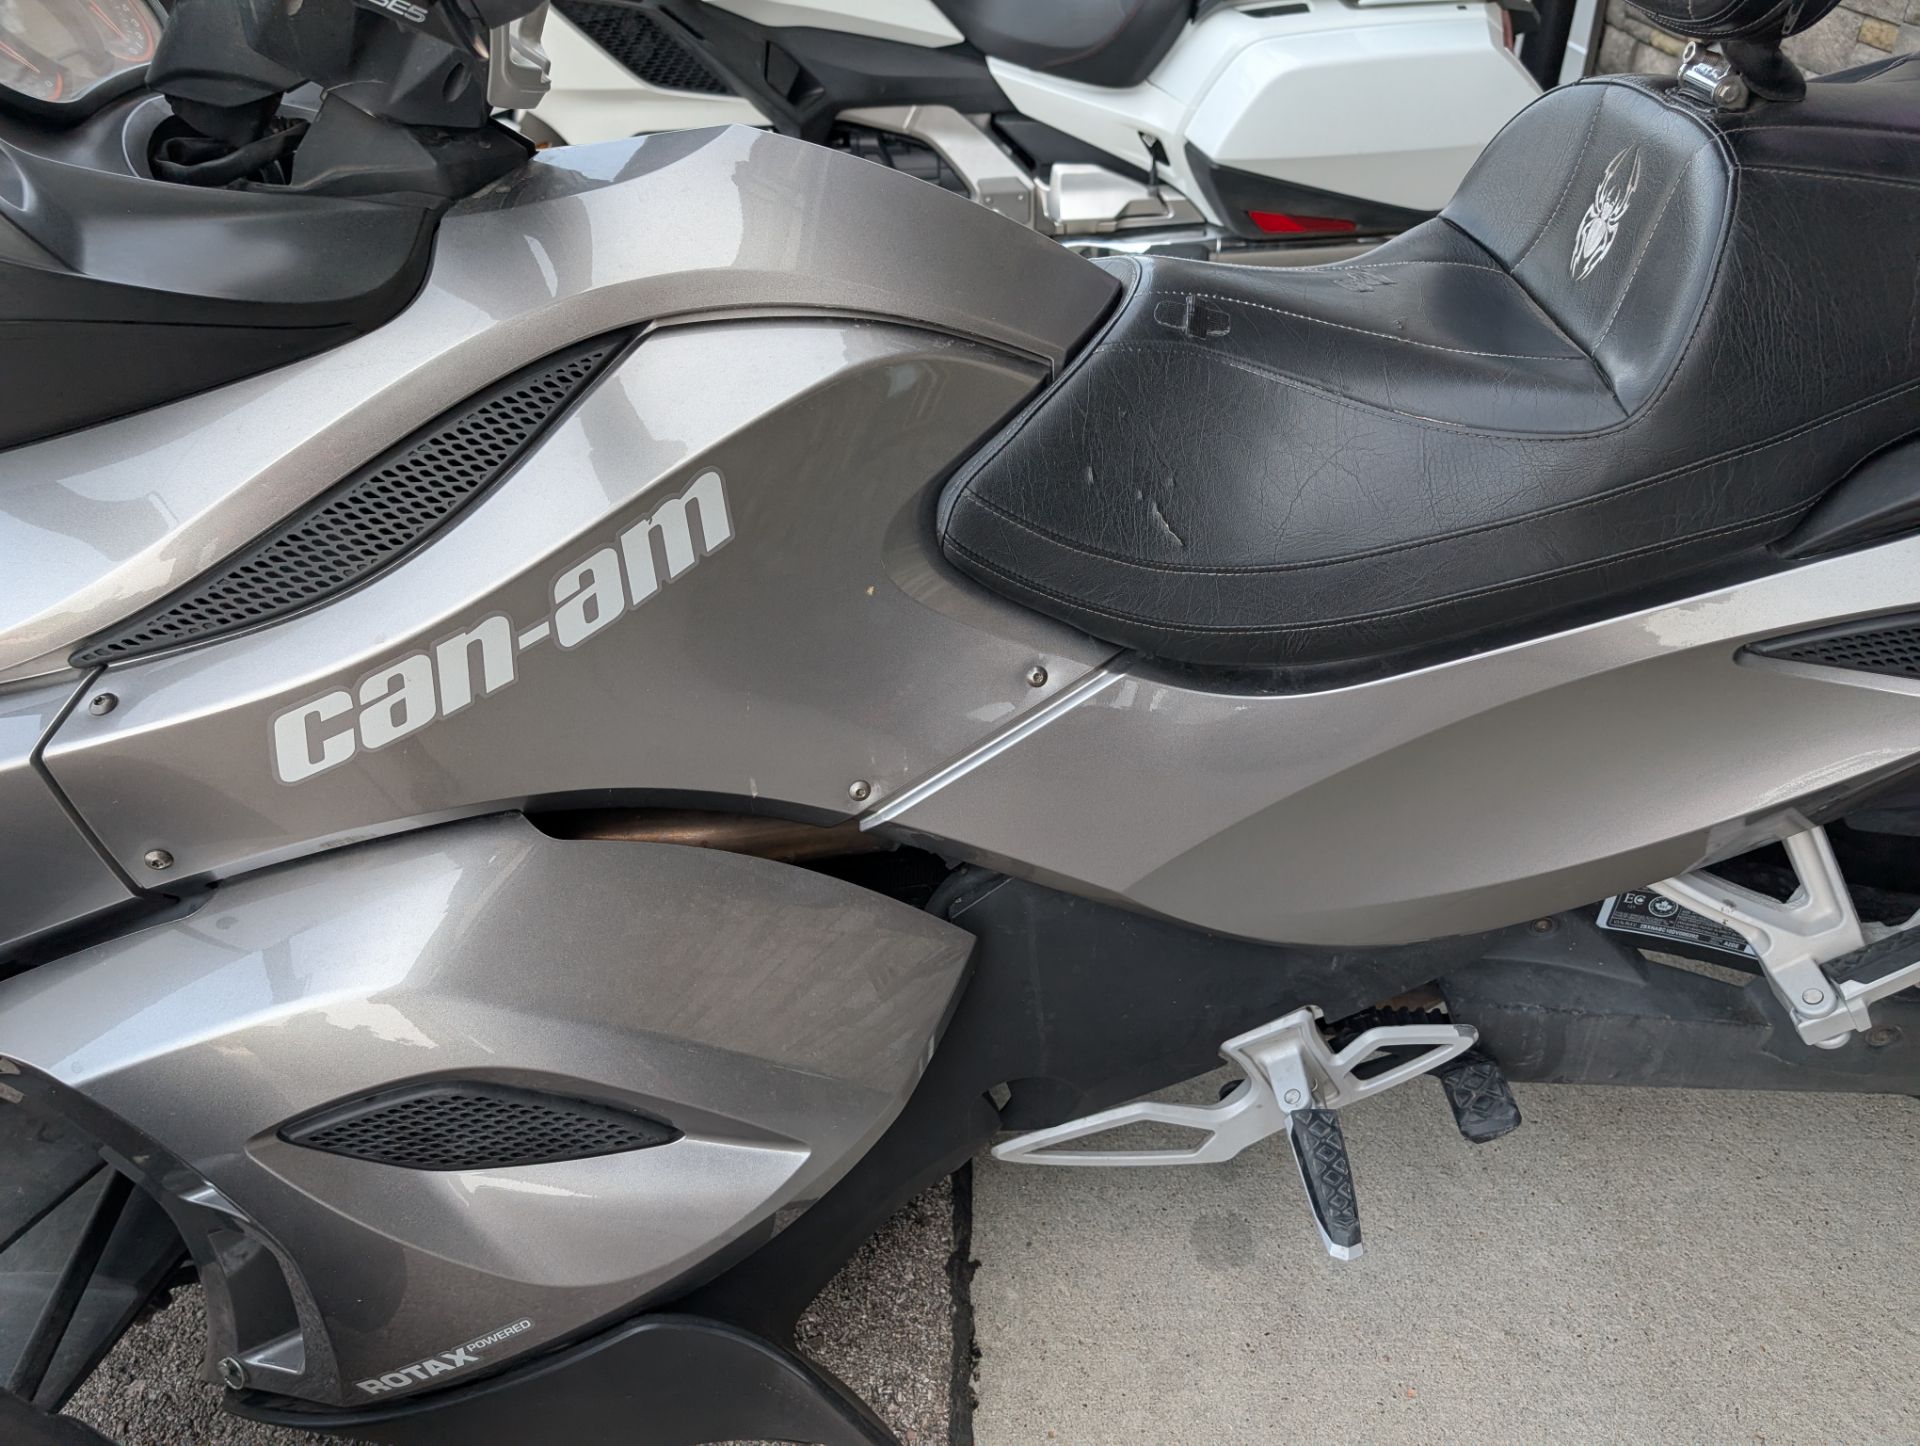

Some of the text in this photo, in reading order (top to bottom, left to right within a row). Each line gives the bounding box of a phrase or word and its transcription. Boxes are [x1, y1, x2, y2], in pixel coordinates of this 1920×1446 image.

[274, 470, 732, 783] can-am
[355, 1319, 532, 1395] ROTAX POWERED
